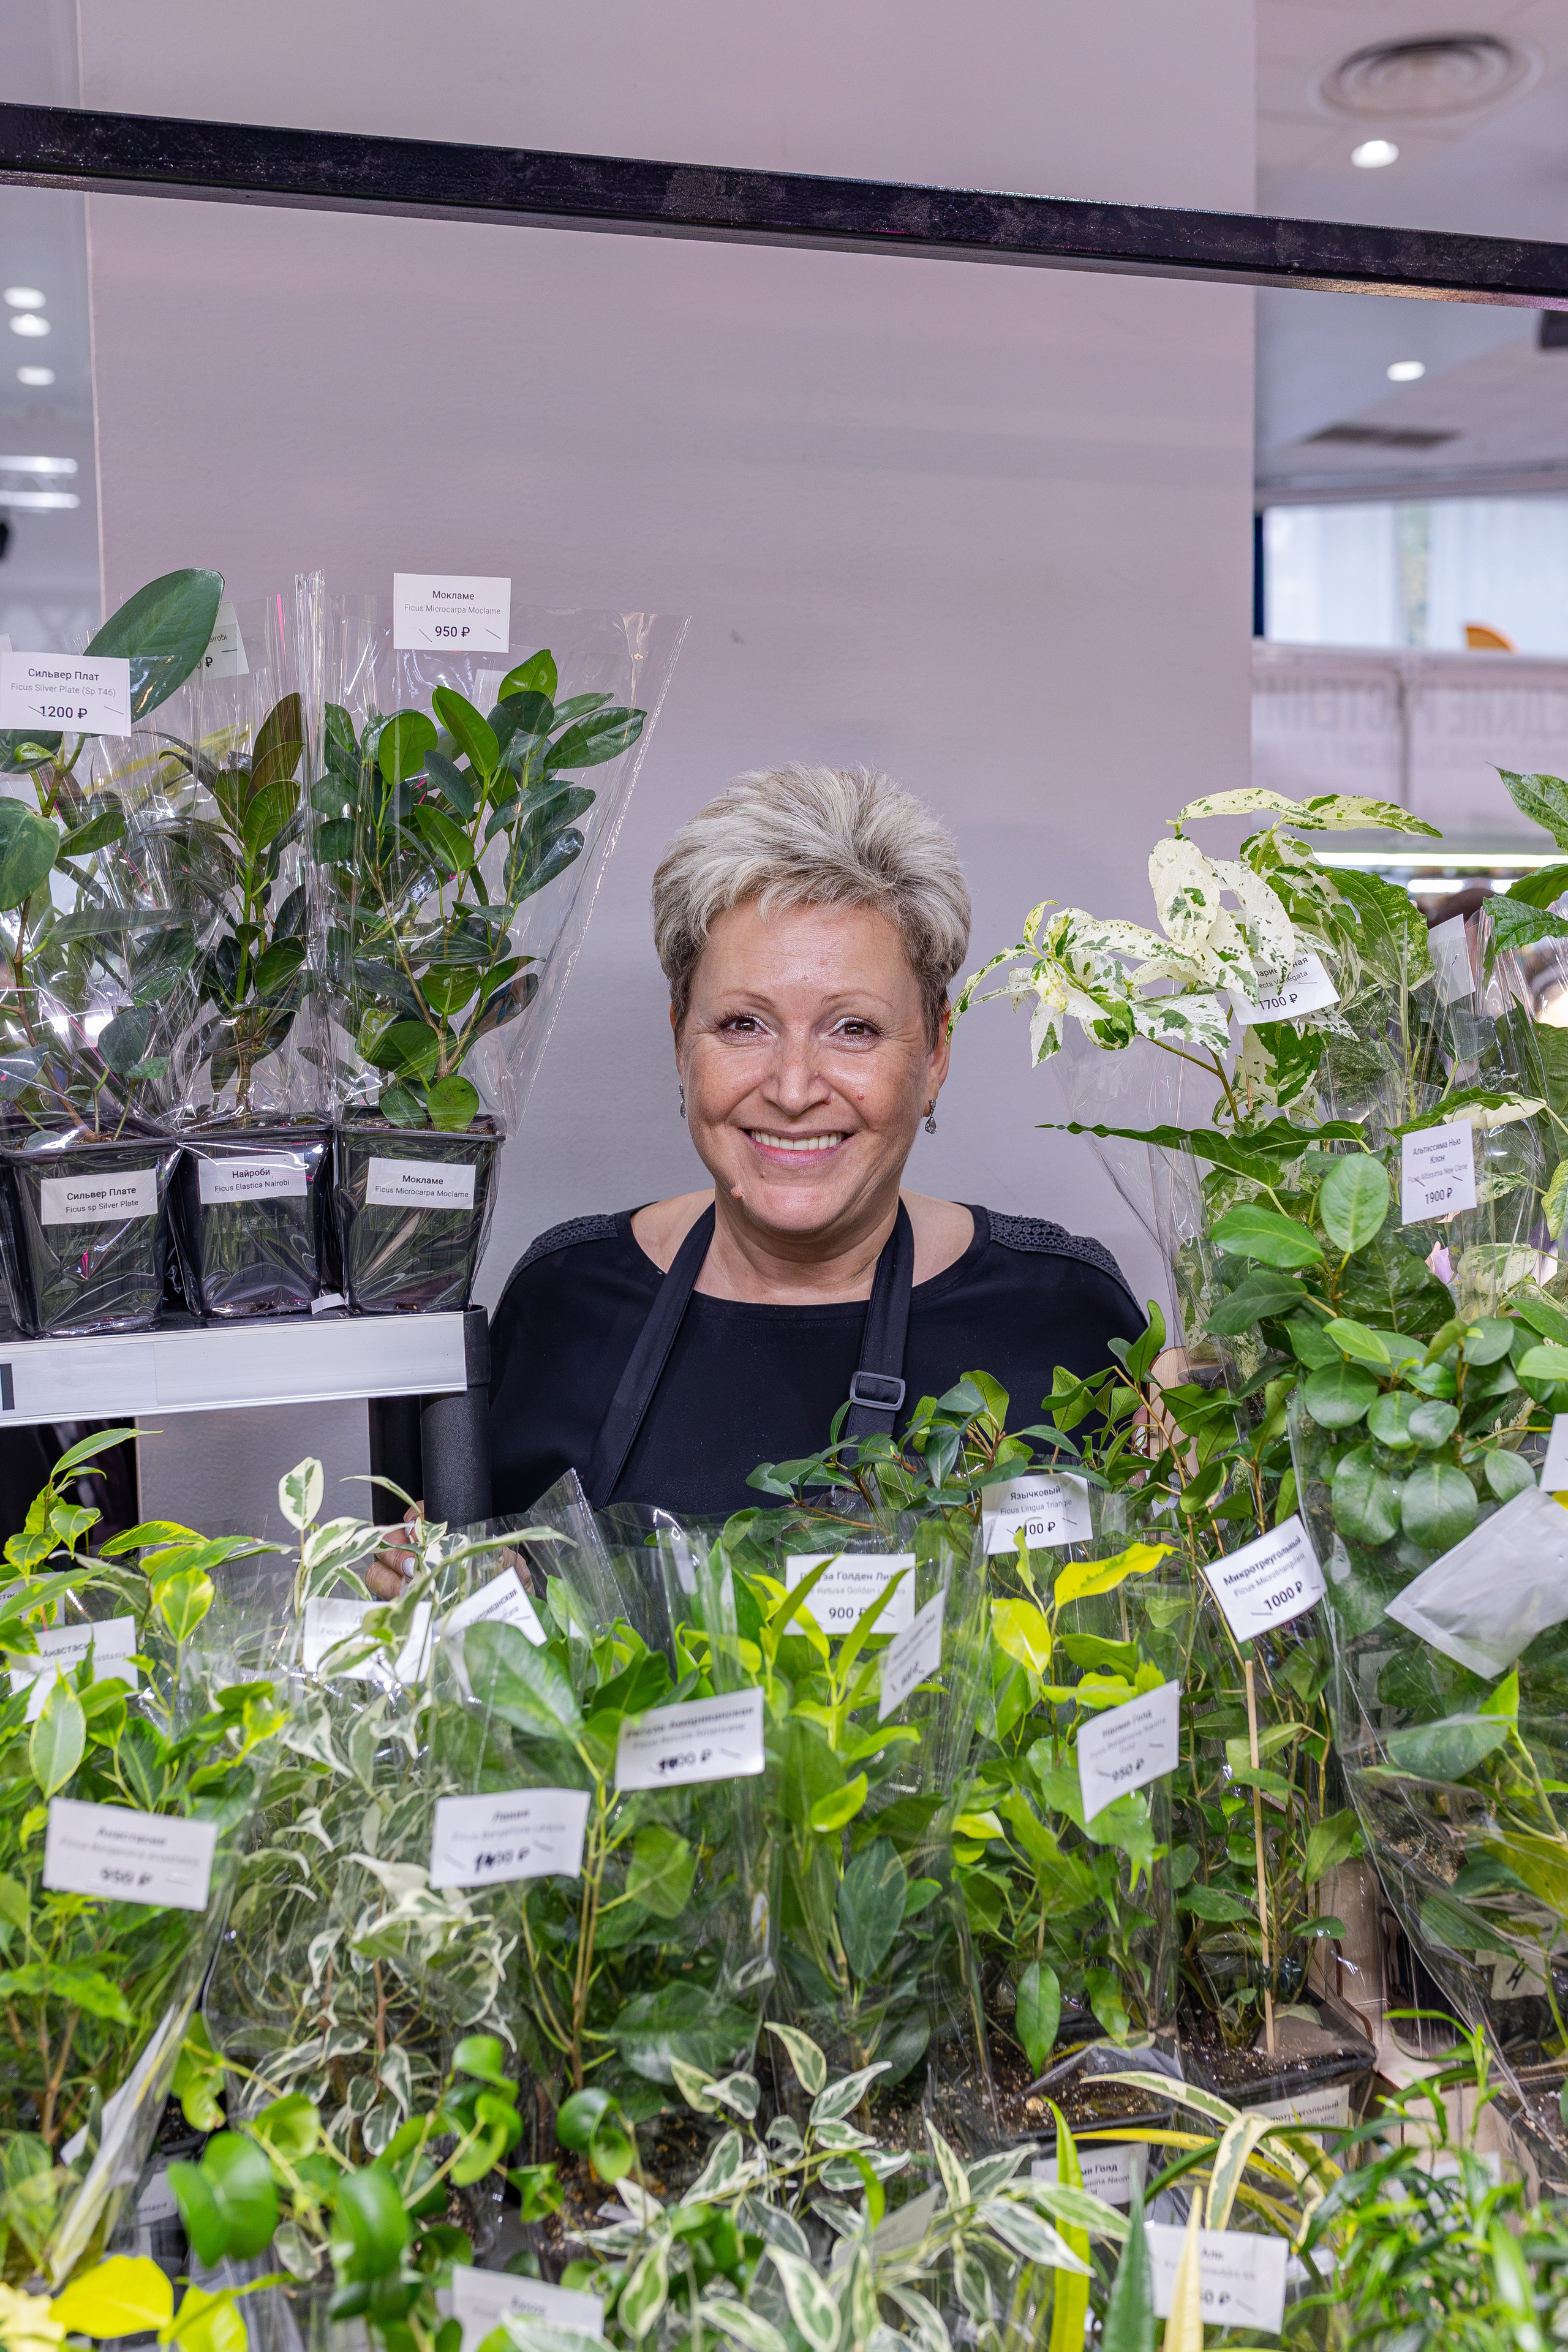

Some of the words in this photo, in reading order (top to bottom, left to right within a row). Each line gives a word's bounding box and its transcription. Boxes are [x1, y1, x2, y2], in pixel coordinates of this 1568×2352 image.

[432, 590, 475, 600] Мокламе
[426, 605, 466, 614] Microcarpa
[435, 626, 458, 637] 950
[28, 668, 72, 681] Сильвер
[75, 671, 99, 681] Плат
[35, 684, 57, 693] Silver
[59, 685, 80, 694] Plate
[82, 687, 96, 696] (Sp
[98, 688, 116, 698] T46)
[40, 706, 73, 718] 1200
[1259, 997, 1287, 1010] 1700
[232, 1168, 271, 1178] Найроби
[265, 1179, 290, 1188] Nairobi
[402, 1175, 443, 1185] Мокламе
[67, 1190, 107, 1200] Сильвер
[109, 1188, 137, 1196] Плате
[396, 1188, 435, 1197] Microcarpa
[1425, 1189, 1445, 1204] 1900
[1011, 1485, 1061, 1501] Язычковый
[1021, 1504, 1044, 1513] Lingua
[1223, 1535, 1302, 1586] Микротреугольный
[1264, 1587, 1295, 1611] 1000
[829, 1607, 854, 1619] 900
